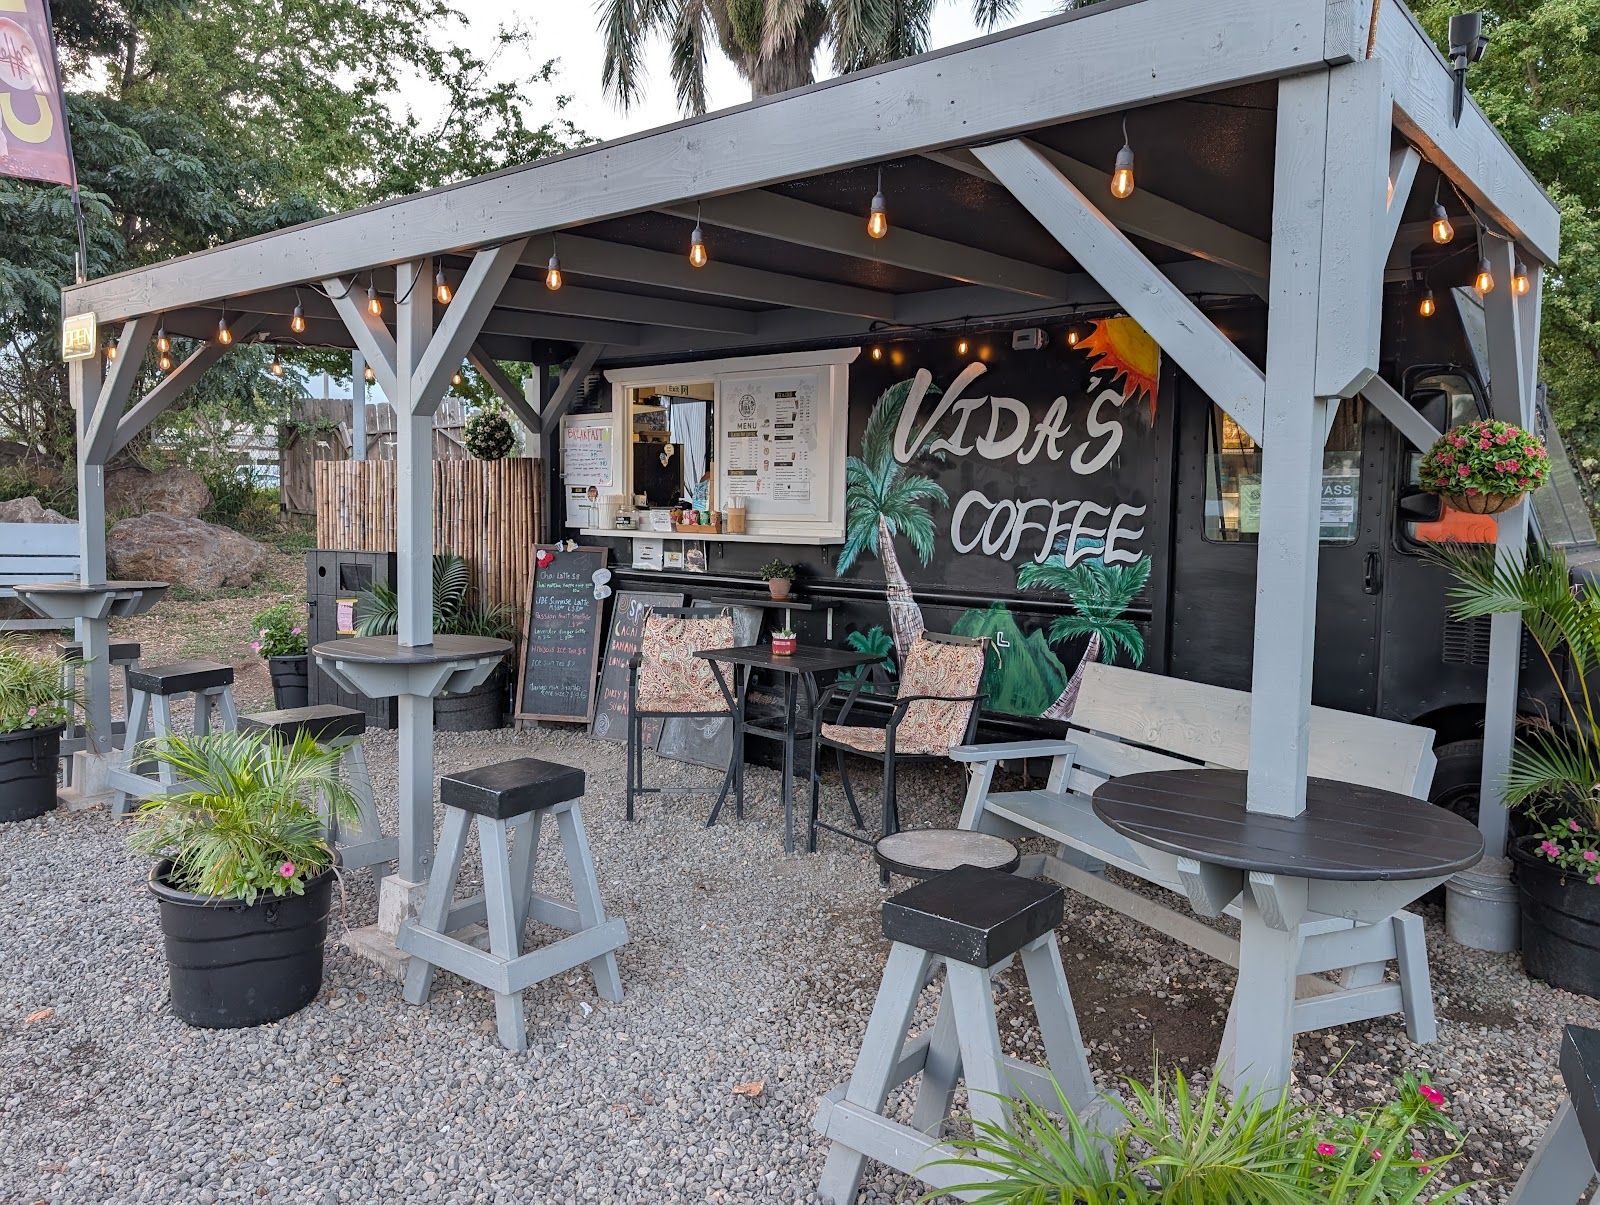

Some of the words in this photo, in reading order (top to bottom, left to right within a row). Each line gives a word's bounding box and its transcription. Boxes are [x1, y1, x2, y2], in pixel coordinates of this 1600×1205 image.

[65, 327, 91, 349] OPEN
[893, 361, 1125, 476] VIDA'S
[737, 422, 757, 430] MENU
[567, 427, 603, 441] BREAKFAST
[1320, 484, 1352, 496] ASS
[951, 490, 1147, 568] COFFEE
[621, 625, 639, 637] ACAI
